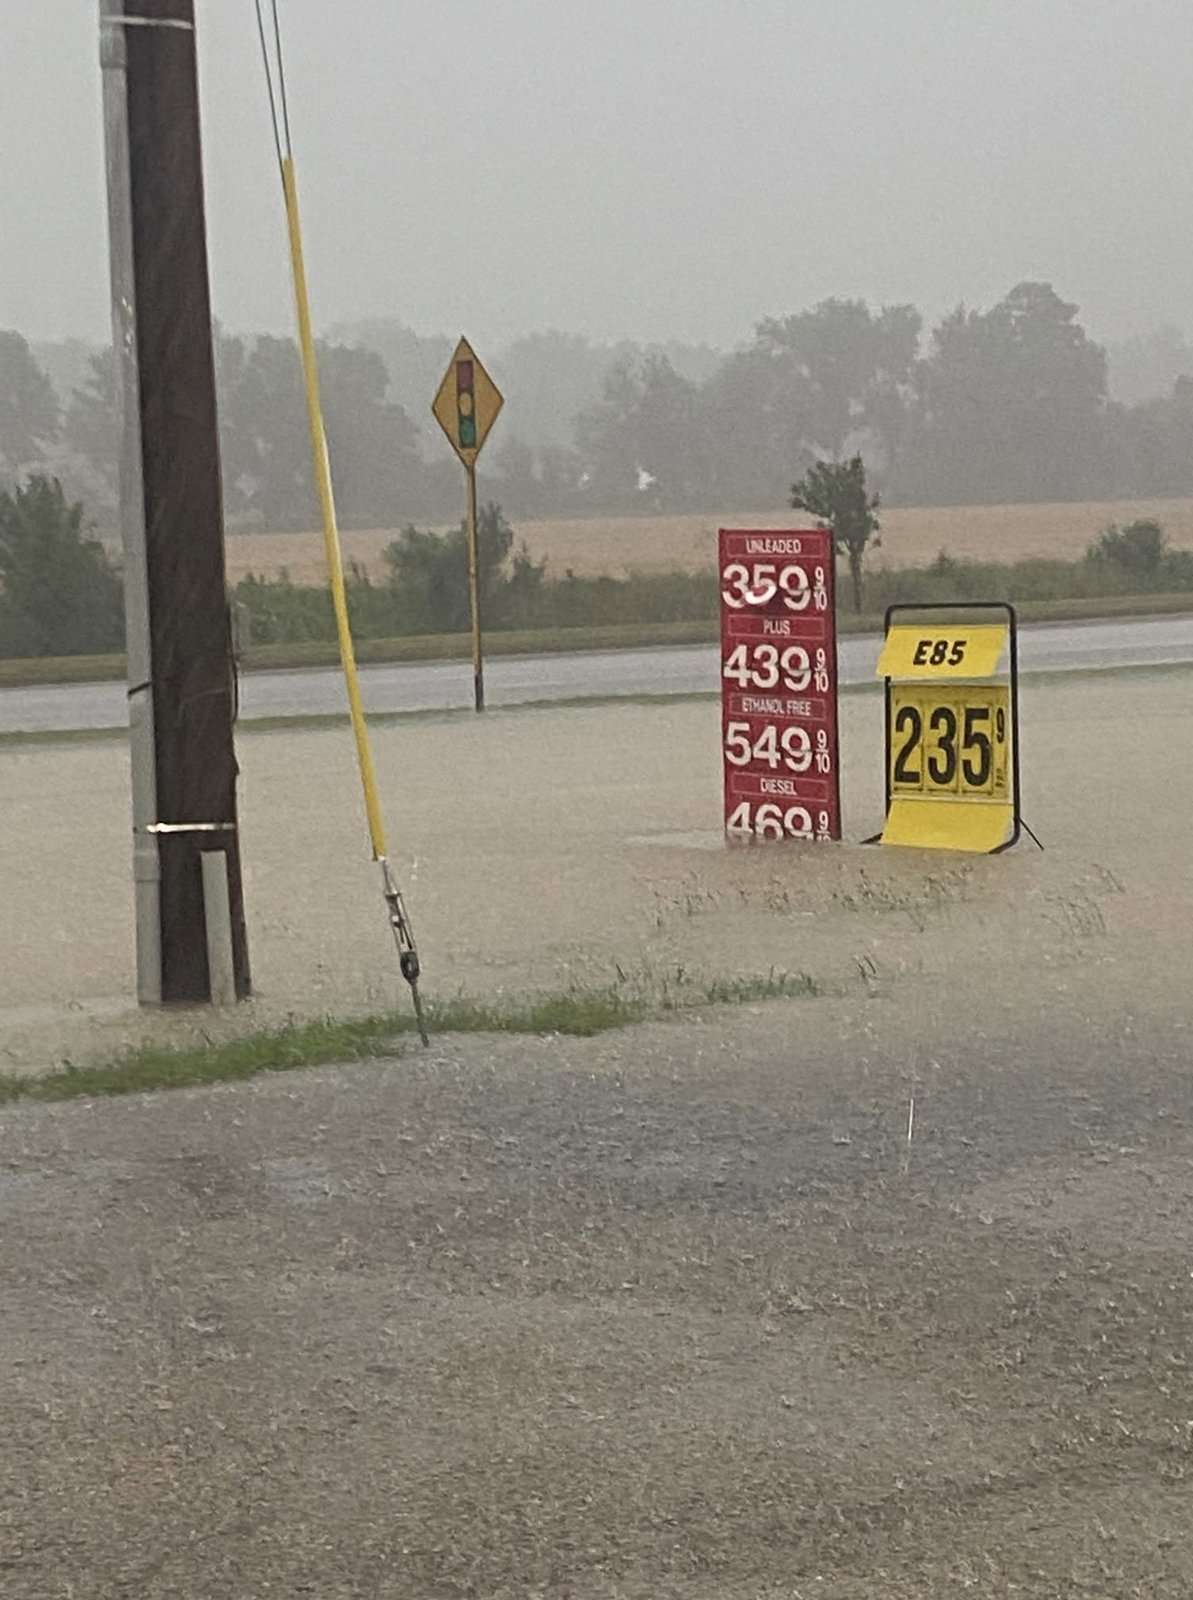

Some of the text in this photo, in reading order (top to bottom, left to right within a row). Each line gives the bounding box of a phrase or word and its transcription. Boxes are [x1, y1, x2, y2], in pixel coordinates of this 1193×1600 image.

[746, 539, 801, 553] UNLEADED
[722, 563, 811, 611] 359
[763, 619, 791, 635] PLUS
[723, 644, 812, 691] 439
[912, 640, 967, 666] E85
[742, 697, 812, 716] ETHANOL FREE
[725, 721, 813, 773] 549
[894, 706, 992, 787] 235
[760, 778, 798, 796] DIESEL
[727, 801, 814, 841] 469
